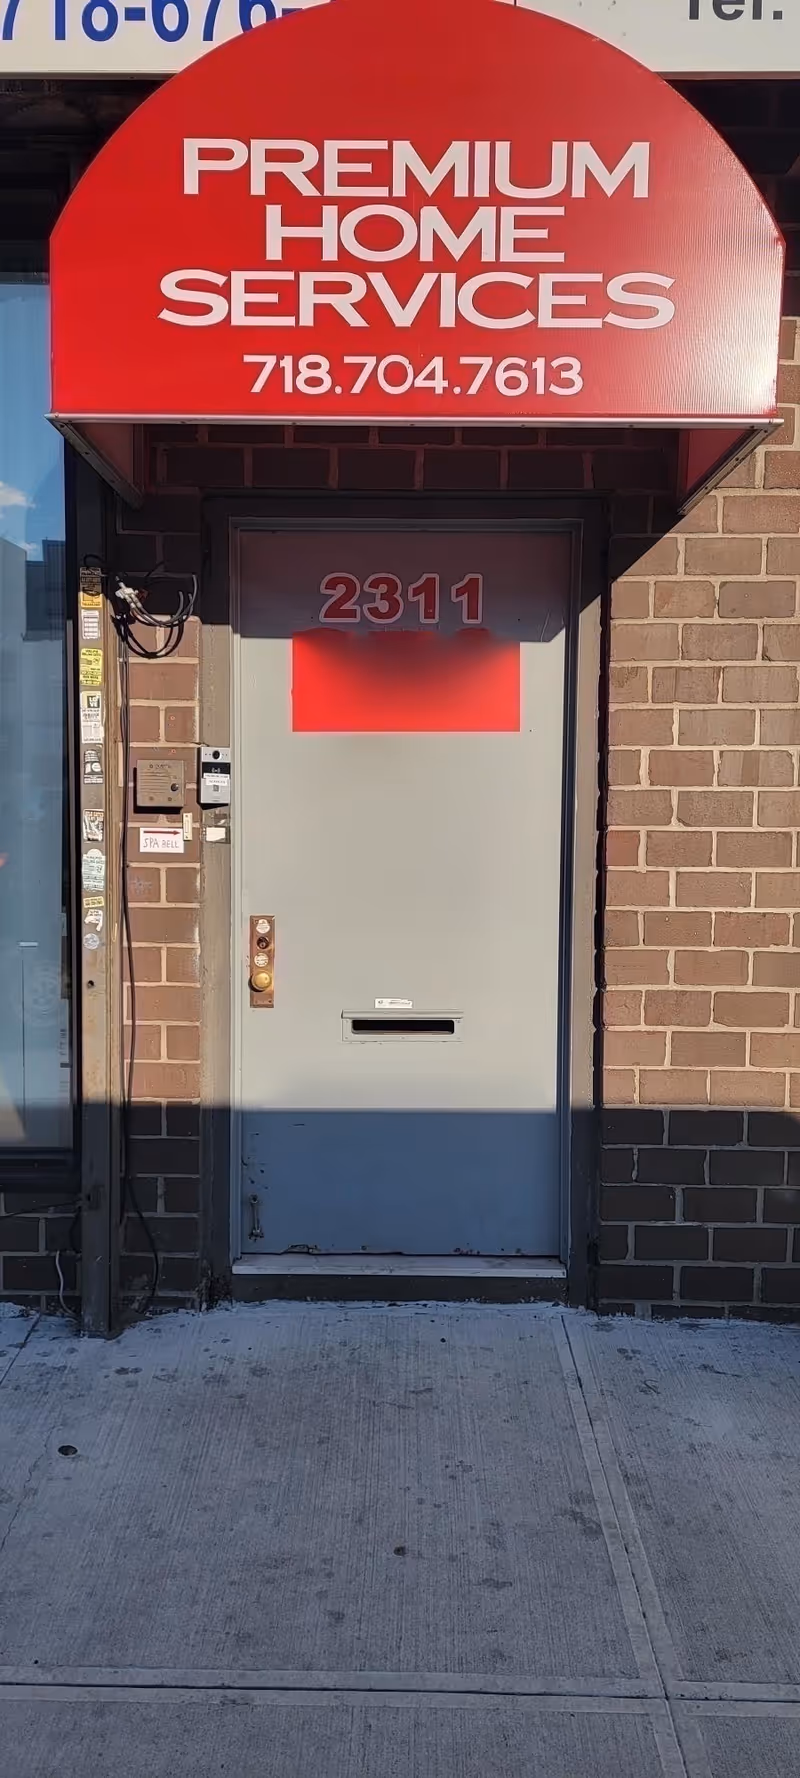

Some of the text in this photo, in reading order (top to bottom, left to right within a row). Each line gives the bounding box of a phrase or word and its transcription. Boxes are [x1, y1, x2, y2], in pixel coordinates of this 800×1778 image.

[183, 138, 651, 199] PREMIUM
[265, 204, 565, 262] HOME
[157, 270, 676, 329] SERVICES
[243, 354, 584, 397] 718.704.7613
[319, 572, 483, 624] 2311
[143, 836, 180, 849] SPA BELL
